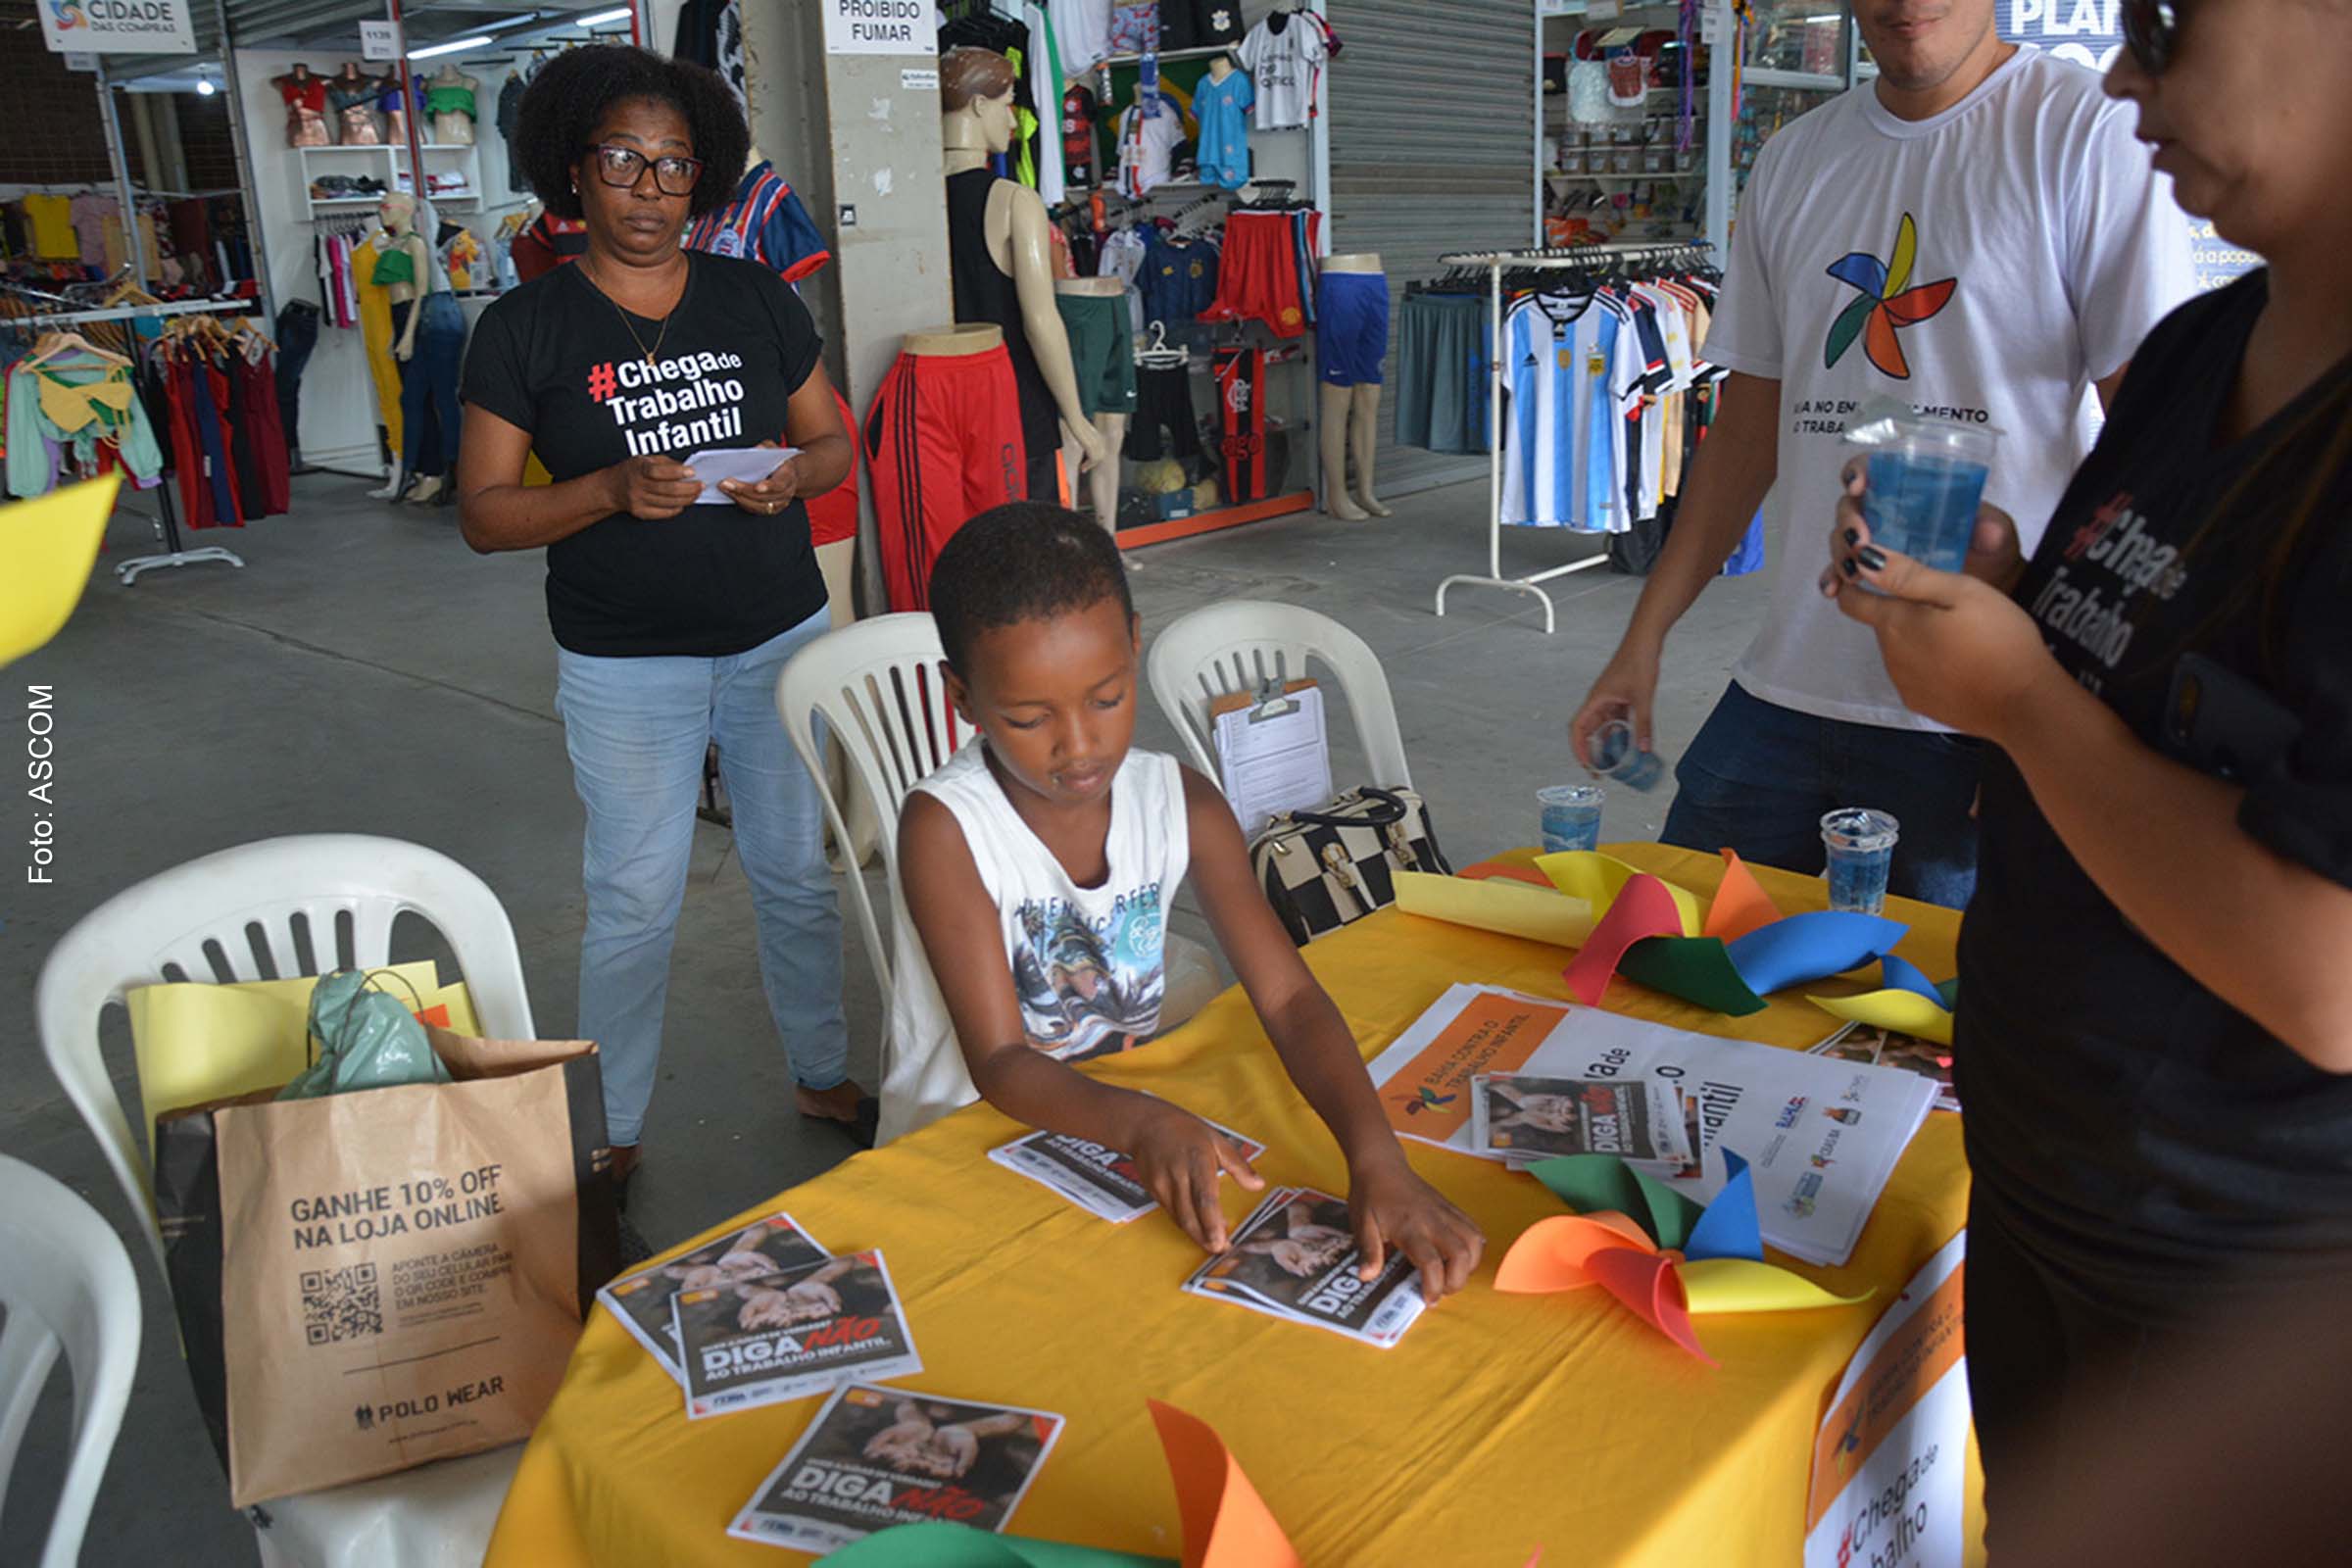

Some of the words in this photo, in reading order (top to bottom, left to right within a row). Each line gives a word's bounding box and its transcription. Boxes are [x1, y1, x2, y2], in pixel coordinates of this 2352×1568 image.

[87, 0, 174, 22] CIDADE
[91, 22, 115, 31] DAS
[117, 22, 176, 33] COMPRAS
[839, 0, 921, 19] PROIBIDO
[852, 23, 912, 41] FUMAR
[606, 378, 745, 426] Trabalho
[624, 407, 743, 457] Infantil
[1802, 419, 1845, 434] TRABA
[1592, 1113, 1620, 1153] DIGA
[1698, 1081, 1744, 1150] antil
[290, 1187, 391, 1223] GANHE
[400, 1179, 455, 1206] 10%
[460, 1164, 503, 1196] OFF
[294, 1224, 333, 1250] NA
[339, 1213, 409, 1245] LOJA
[414, 1193, 506, 1231] ONLINE
[393, 1255, 439, 1272] APONTE
[393, 1272, 411, 1285] DO
[702, 1335, 803, 1372] DIGA
[802, 1314, 880, 1354] NÃO
[705, 1367, 731, 1382] AO
[731, 1350, 816, 1377] TRABALHO
[817, 1336, 888, 1358] INFANTIL
[378, 1395, 439, 1422] POLO
[447, 1375, 505, 1407] WEAR
[780, 1488, 808, 1502] AO
[808, 1491, 896, 1518] TRABALHO
[790, 1465, 895, 1506] DIGA
[1871, 1501, 1928, 1568] balho
